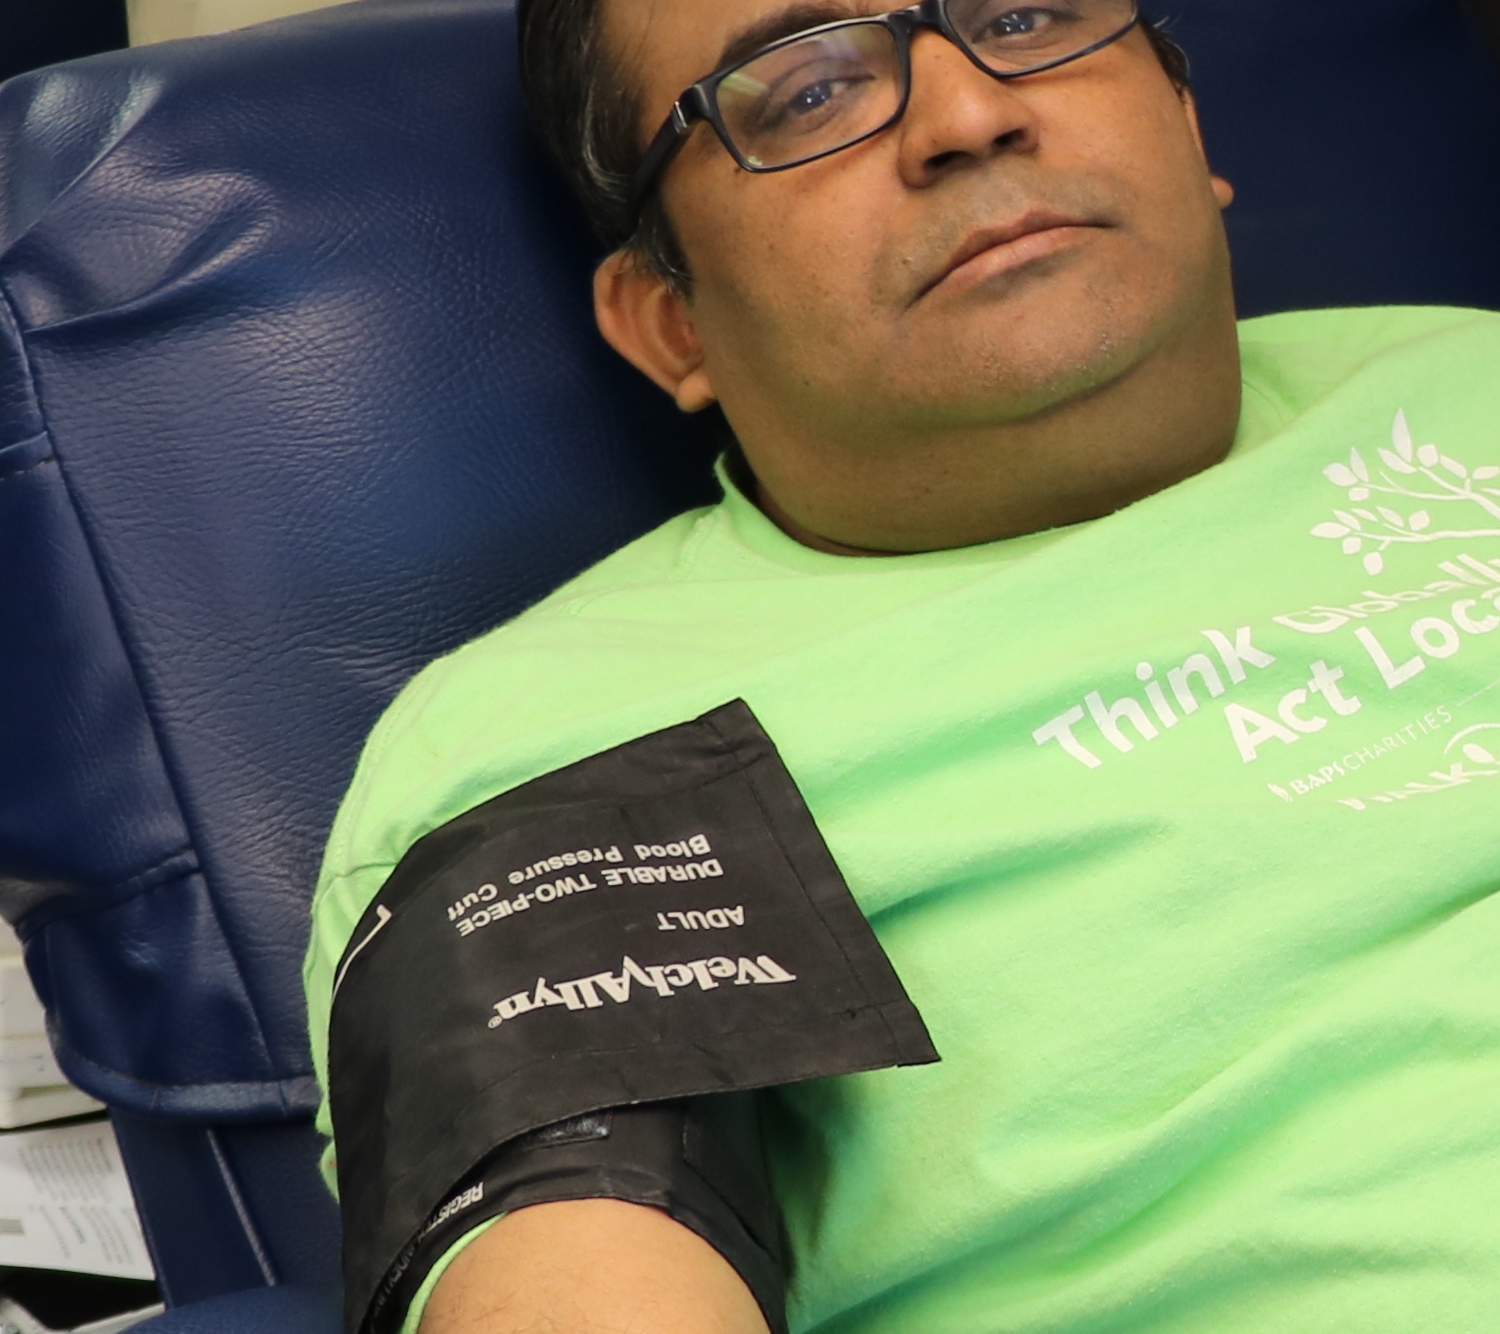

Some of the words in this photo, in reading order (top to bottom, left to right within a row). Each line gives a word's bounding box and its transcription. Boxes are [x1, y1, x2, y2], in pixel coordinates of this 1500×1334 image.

[1032, 625, 1277, 771] Think
[1222, 658, 1362, 764] Act
[507, 845, 624, 885] Pressure
[633, 833, 712, 861] Blood
[600, 858, 725, 887] DURABLE
[446, 883, 499, 922] Cuff
[455, 873, 598, 938] TWO-PIECE
[655, 904, 746, 932] ADULT
